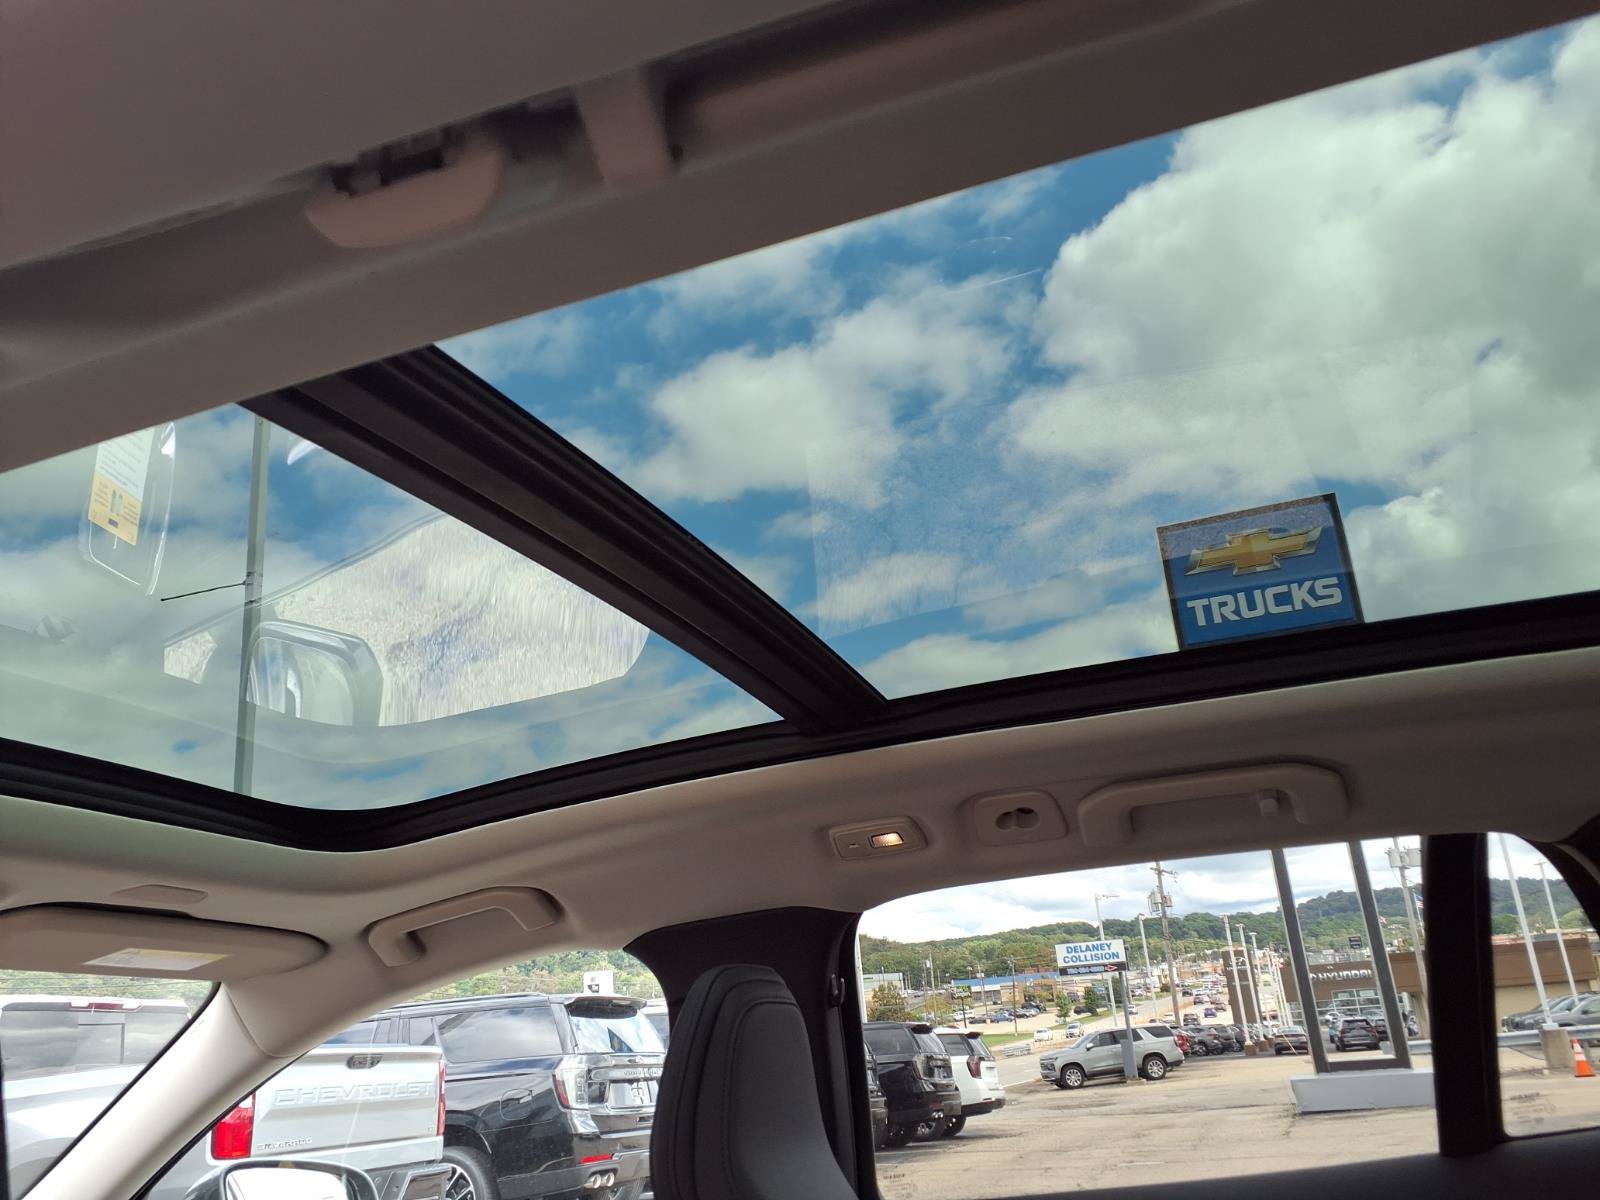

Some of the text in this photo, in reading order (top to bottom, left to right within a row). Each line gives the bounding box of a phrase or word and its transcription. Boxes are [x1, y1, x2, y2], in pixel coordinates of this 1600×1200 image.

[1186, 576, 1343, 626] TRUCKS
[1063, 951, 1120, 964] COLLISION
[1066, 942, 1112, 954] DELANEY
[275, 1081, 434, 1106] CHEVROLET
